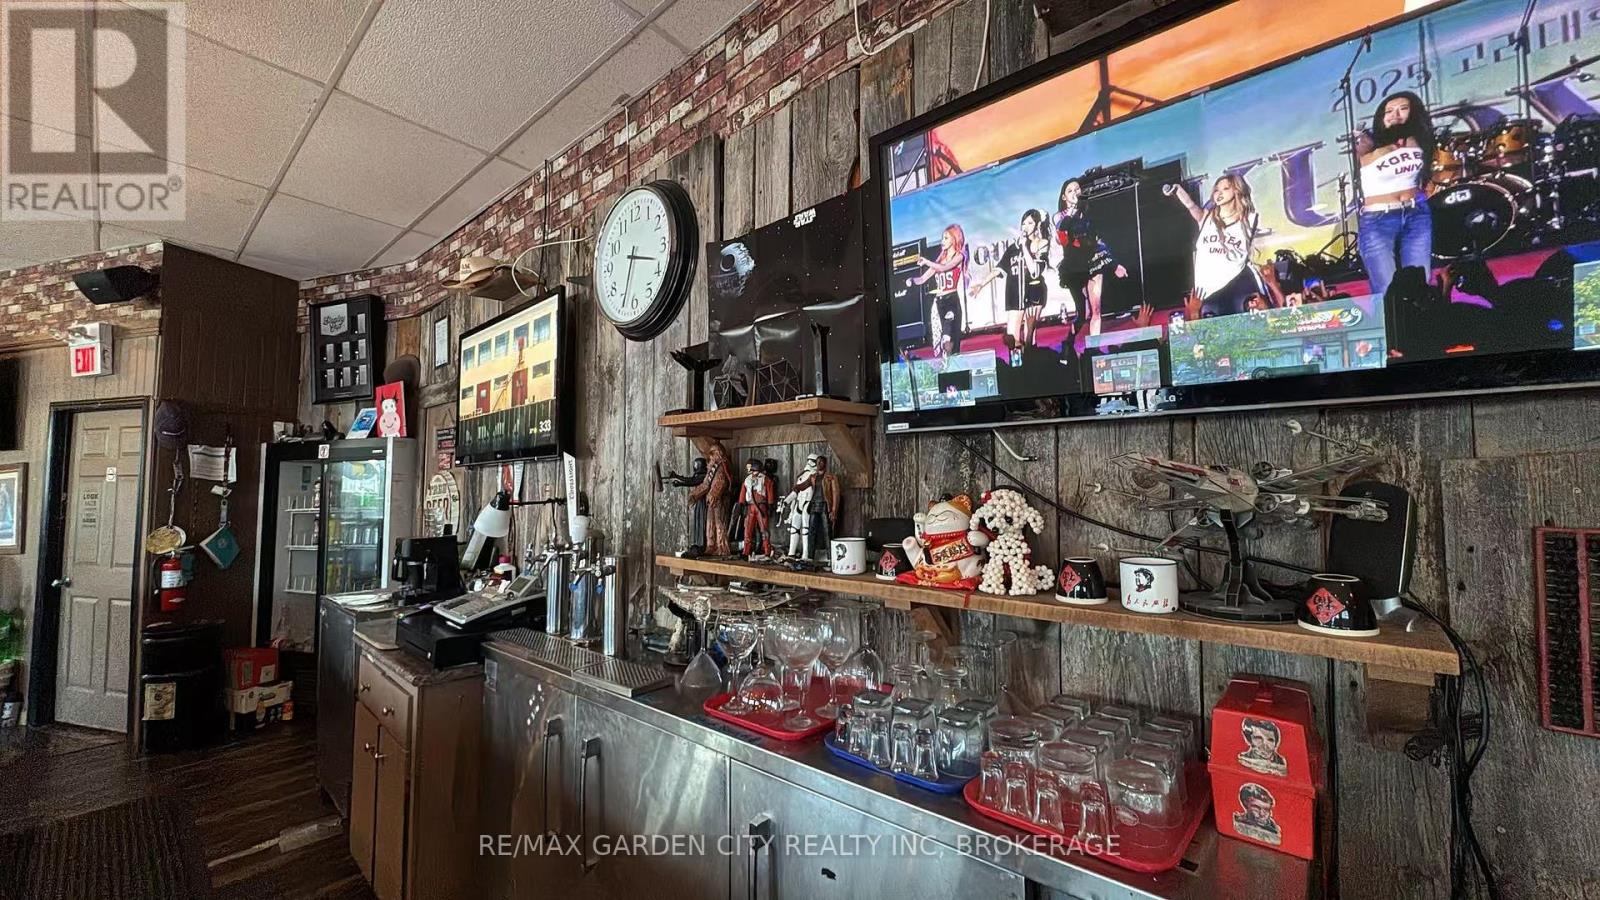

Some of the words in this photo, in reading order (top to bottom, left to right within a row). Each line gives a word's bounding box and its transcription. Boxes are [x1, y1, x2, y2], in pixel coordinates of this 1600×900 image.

[1376, 150, 1423, 171] KORE
[630, 205, 641, 223] 12
[646, 206, 650, 220] 1
[619, 219, 627, 236] 11
[654, 214, 661, 231] 2
[610, 239, 621, 257] 10
[660, 236, 667, 253] 3
[606, 261, 614, 278] 9
[653, 261, 661, 277] 4
[610, 281, 617, 297] 8
[645, 281, 653, 299] 5
[631, 293, 639, 310] 6
[75, 346, 95, 373] EXIT
[1164, 394, 1176, 402] LG
